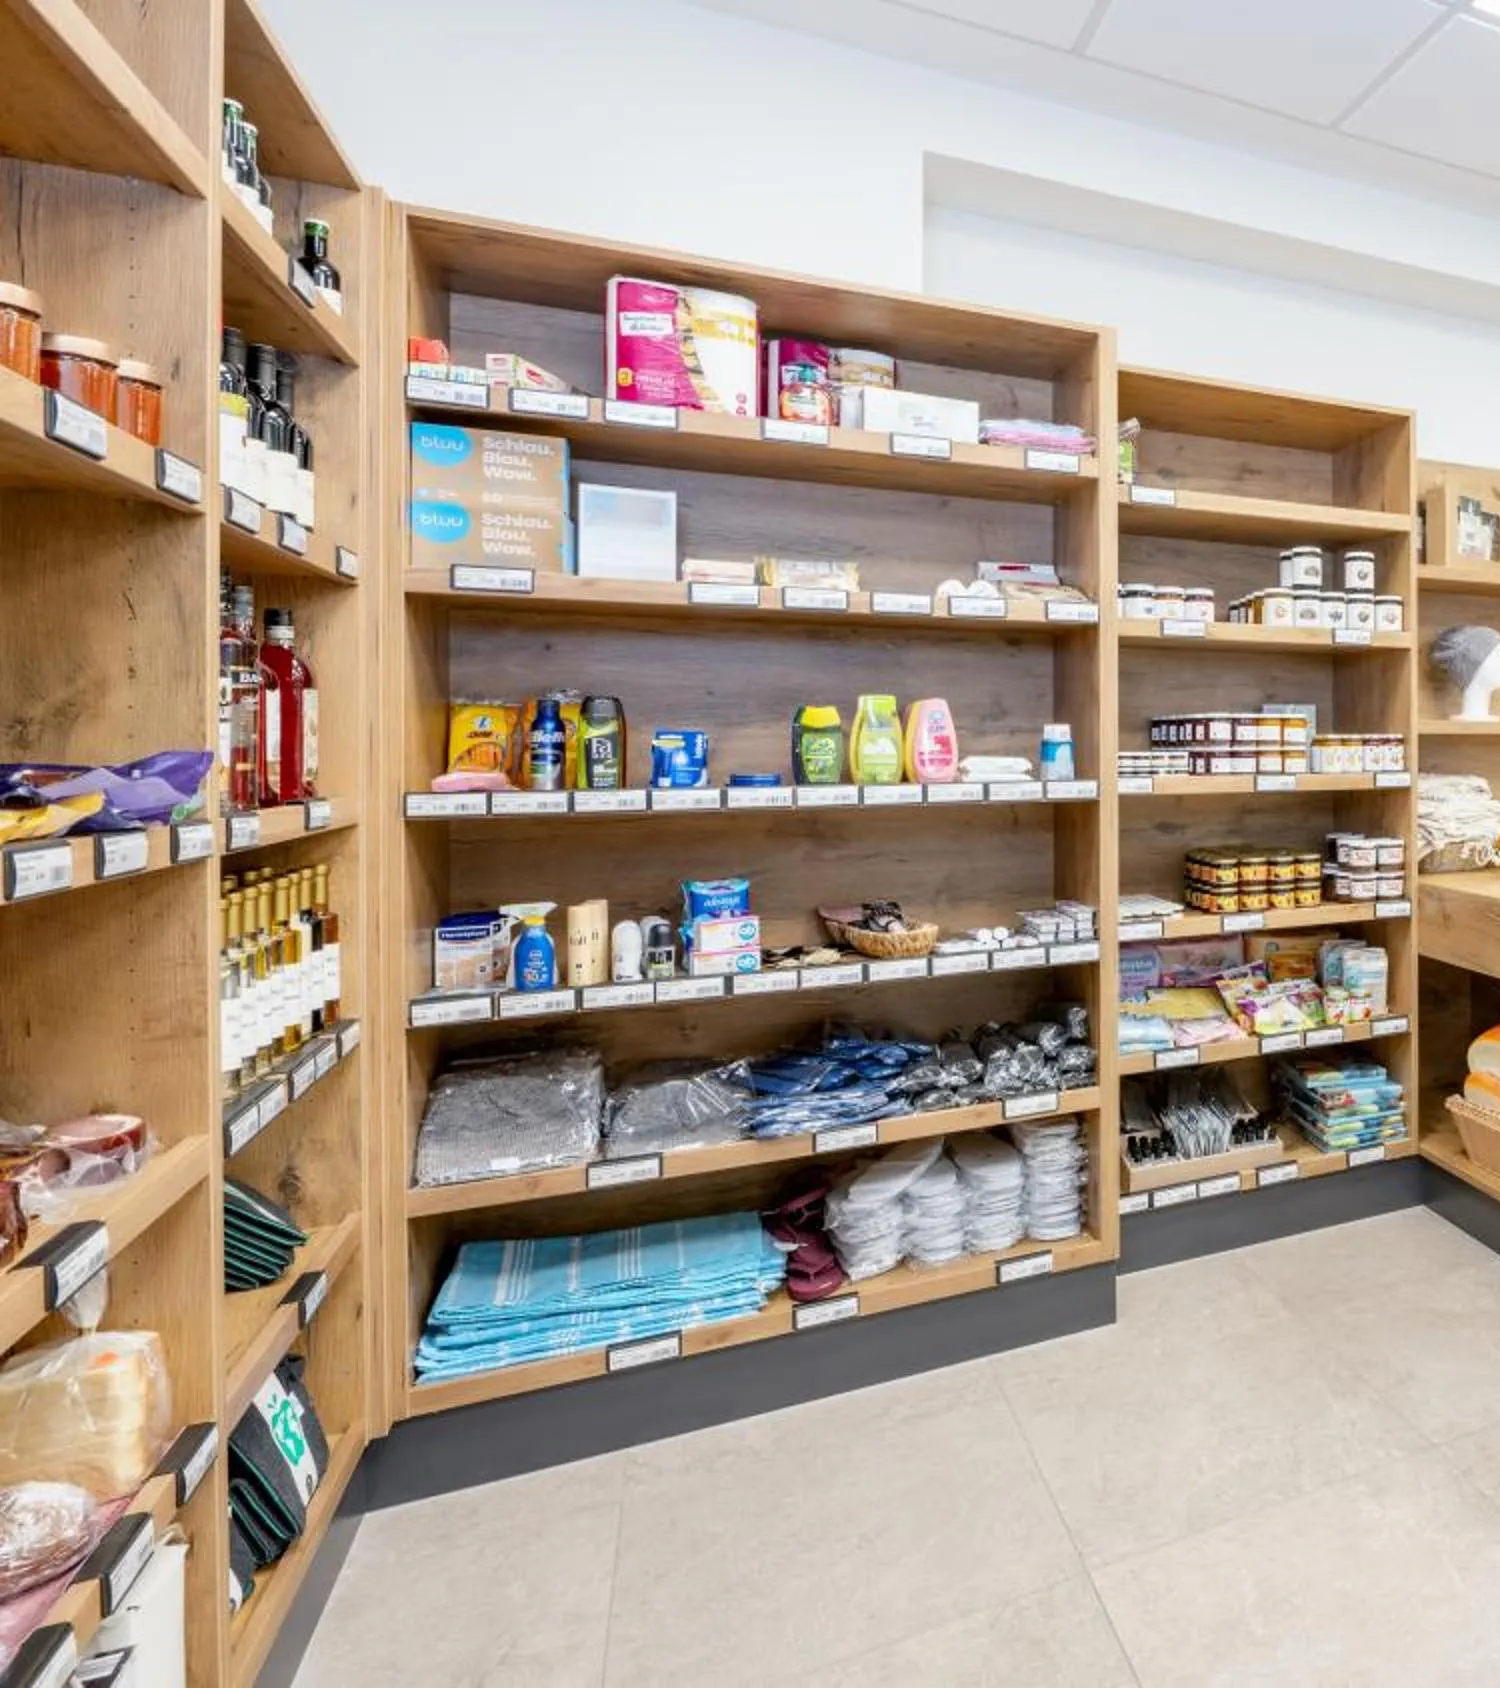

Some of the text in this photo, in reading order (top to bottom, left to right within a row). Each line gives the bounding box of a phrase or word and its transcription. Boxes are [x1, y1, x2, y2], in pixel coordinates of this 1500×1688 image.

[482, 435, 556, 456] Schlau.
[483, 451, 532, 468] Blau.
[482, 464, 538, 482] Wow.
[481, 512, 554, 530] Schlau.
[482, 527, 532, 544] Blau.
[482, 541, 537, 558] Wow.
